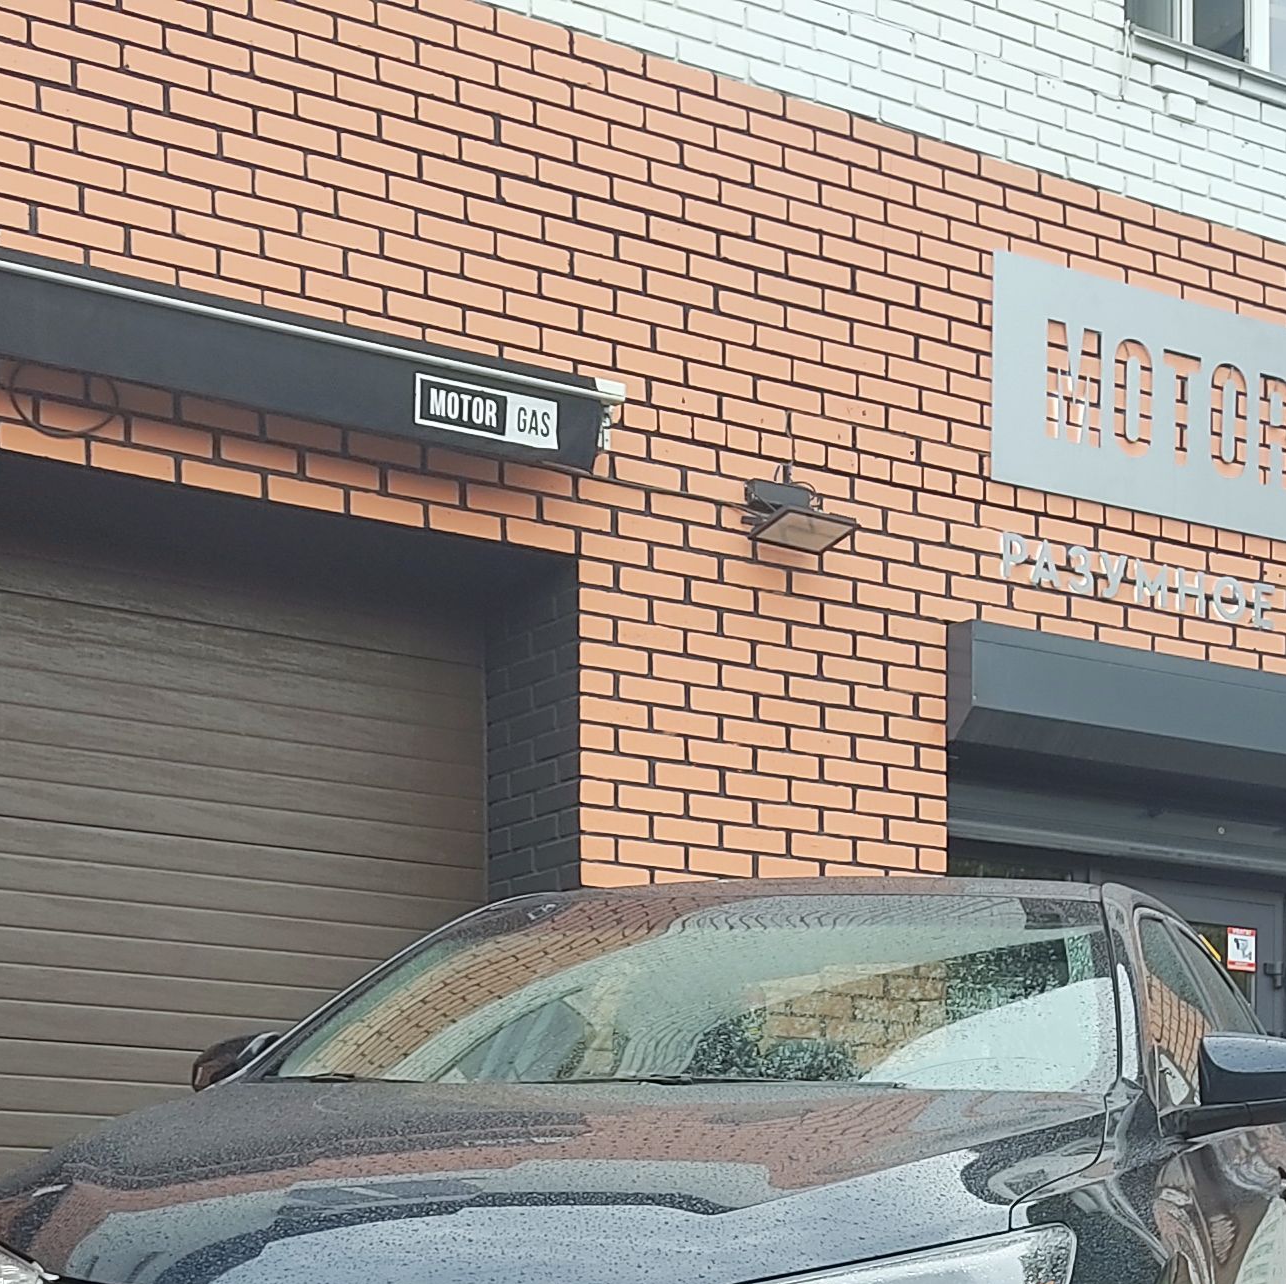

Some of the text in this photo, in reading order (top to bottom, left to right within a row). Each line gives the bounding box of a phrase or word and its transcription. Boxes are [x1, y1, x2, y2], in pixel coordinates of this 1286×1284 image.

[429, 387, 551, 438] MOTOR GAS
[1000, 530, 1275, 631] РАЗУМНОЕ
